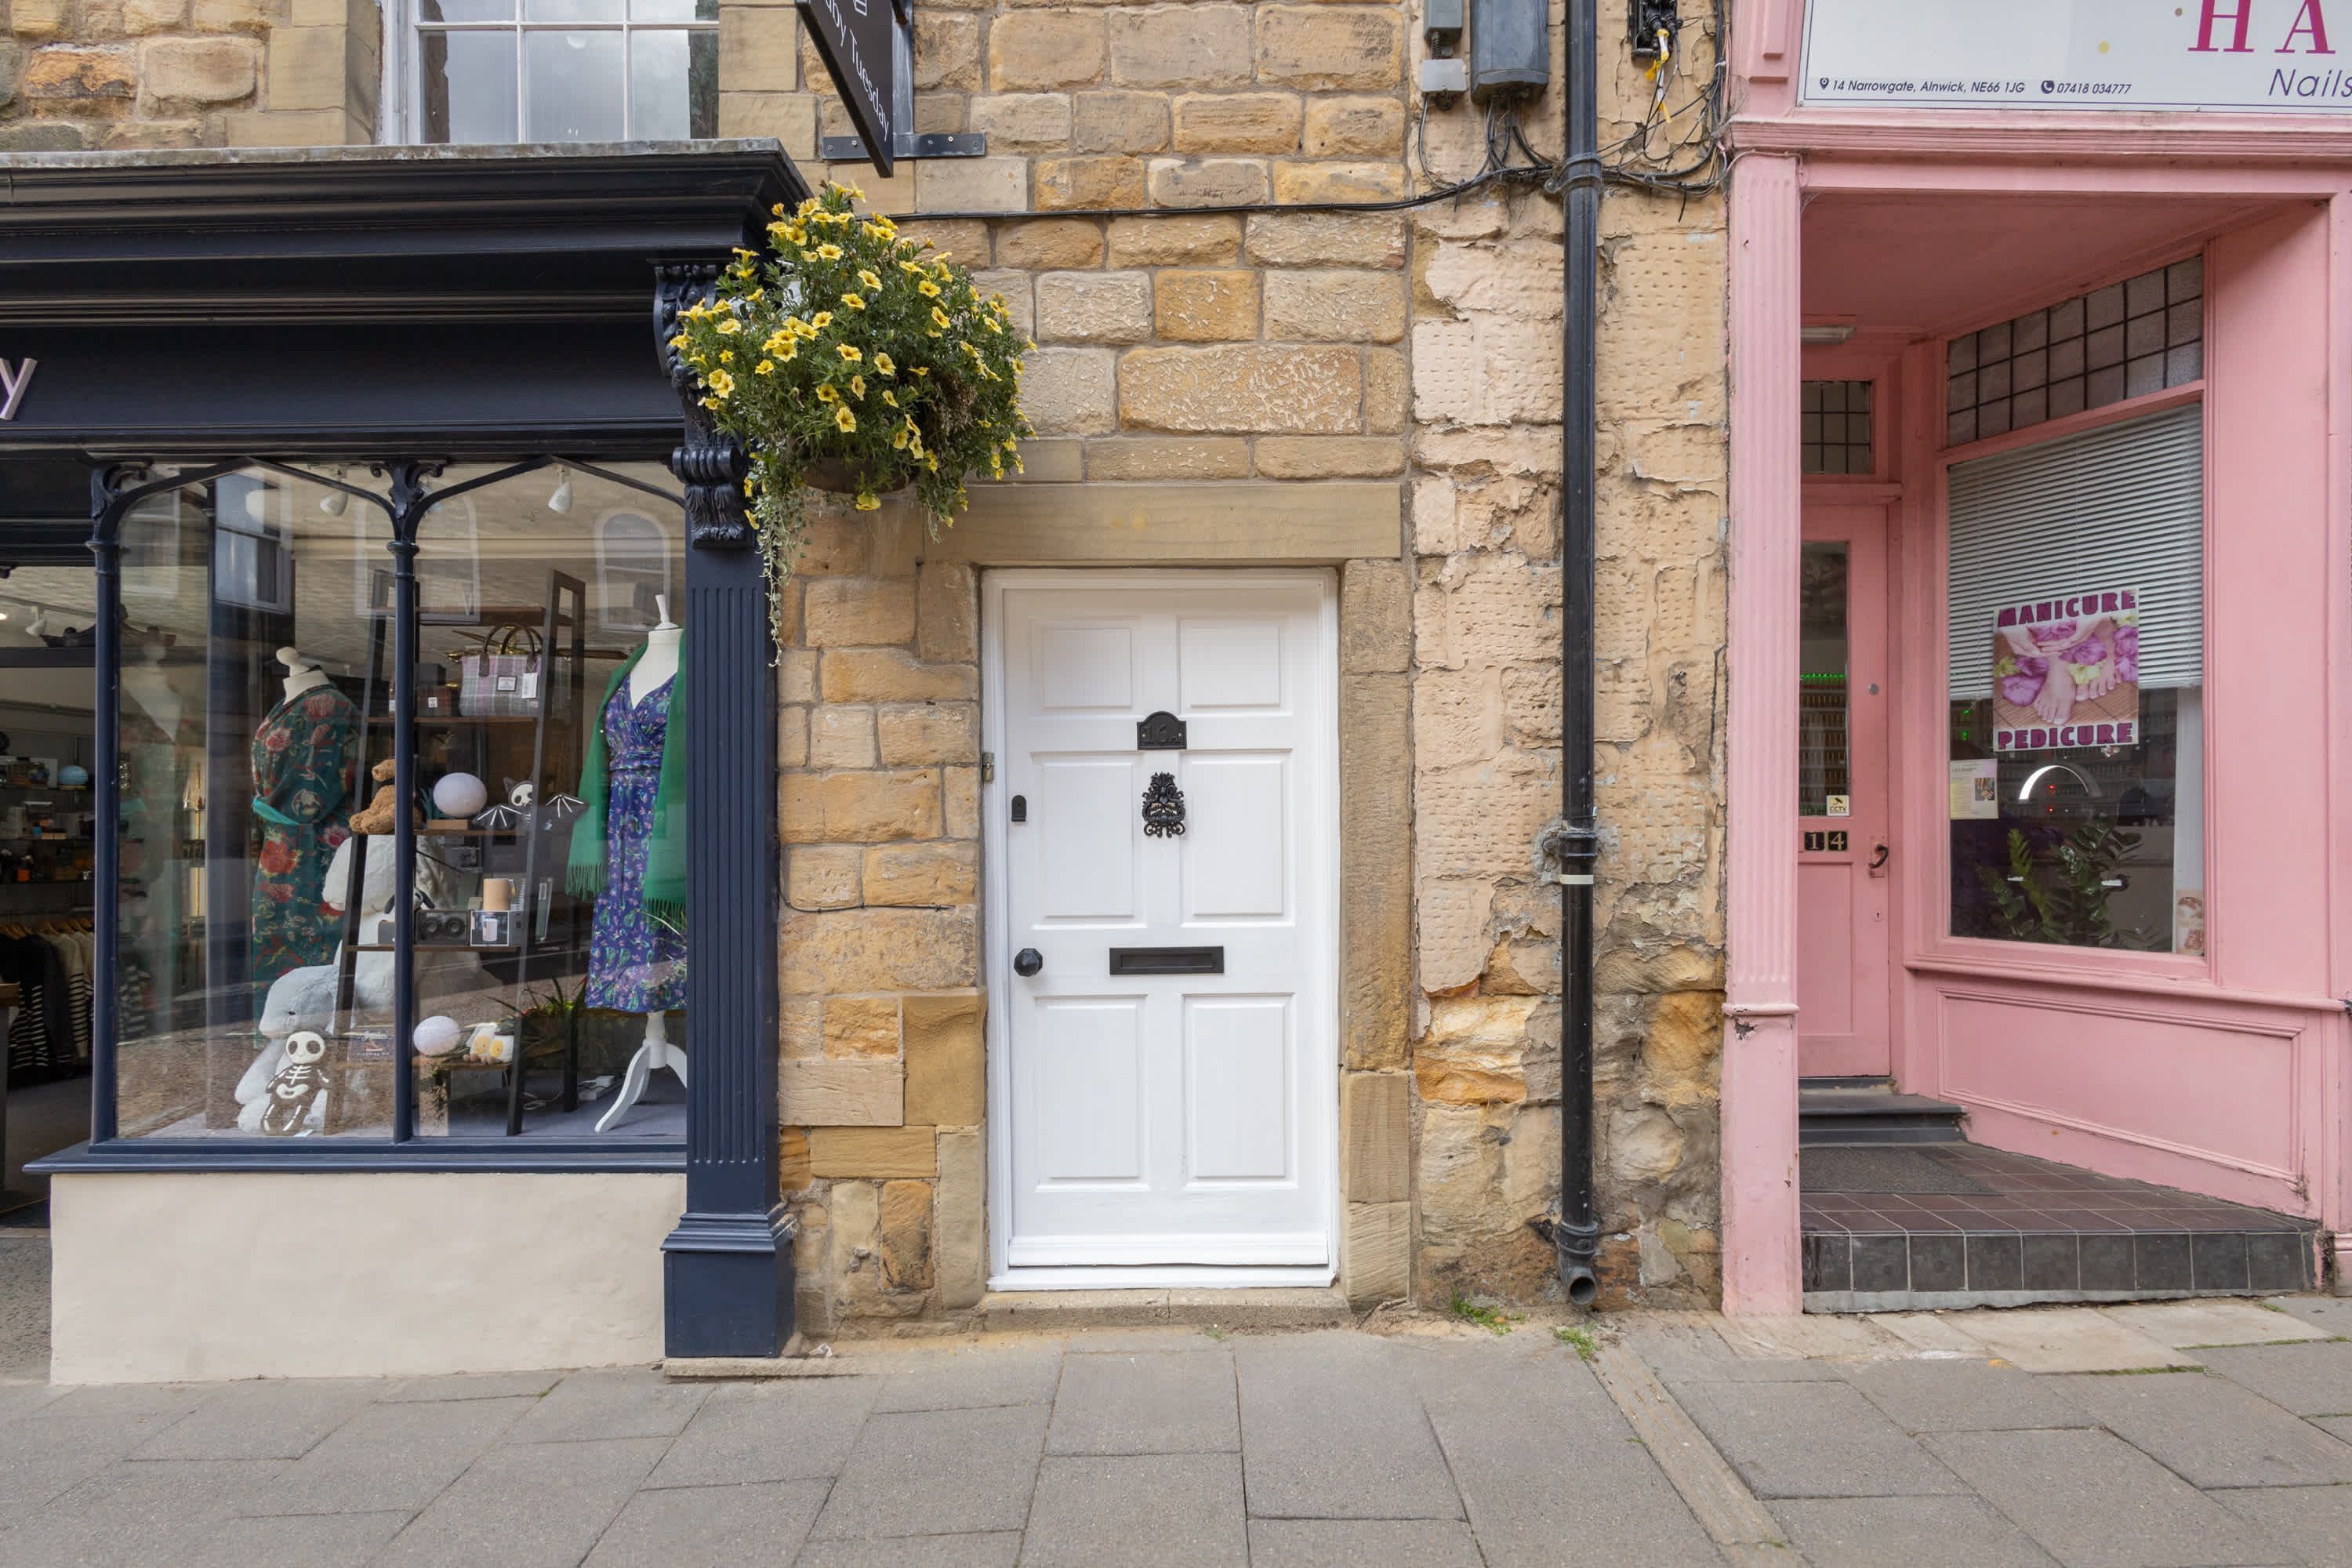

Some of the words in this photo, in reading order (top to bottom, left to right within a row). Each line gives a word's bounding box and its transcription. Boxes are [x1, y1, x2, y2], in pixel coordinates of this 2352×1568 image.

[849, 28, 889, 142] Tuesday
[1833, 81, 1845, 91] 14
[1848, 81, 1916, 93] Narrowgate,
[1920, 82, 1966, 93] Alnwick,
[1970, 82, 2000, 93] NE66
[2005, 82, 2026, 93] 1JG
[2056, 83, 2089, 93] 07418
[2092, 84, 2132, 94] 034777
[2268, 68, 2352, 97] Nails
[1998, 590, 2136, 628] MANICURE
[1998, 722, 2132, 750] PEDICURE
[1809, 832, 1845, 851] 14
